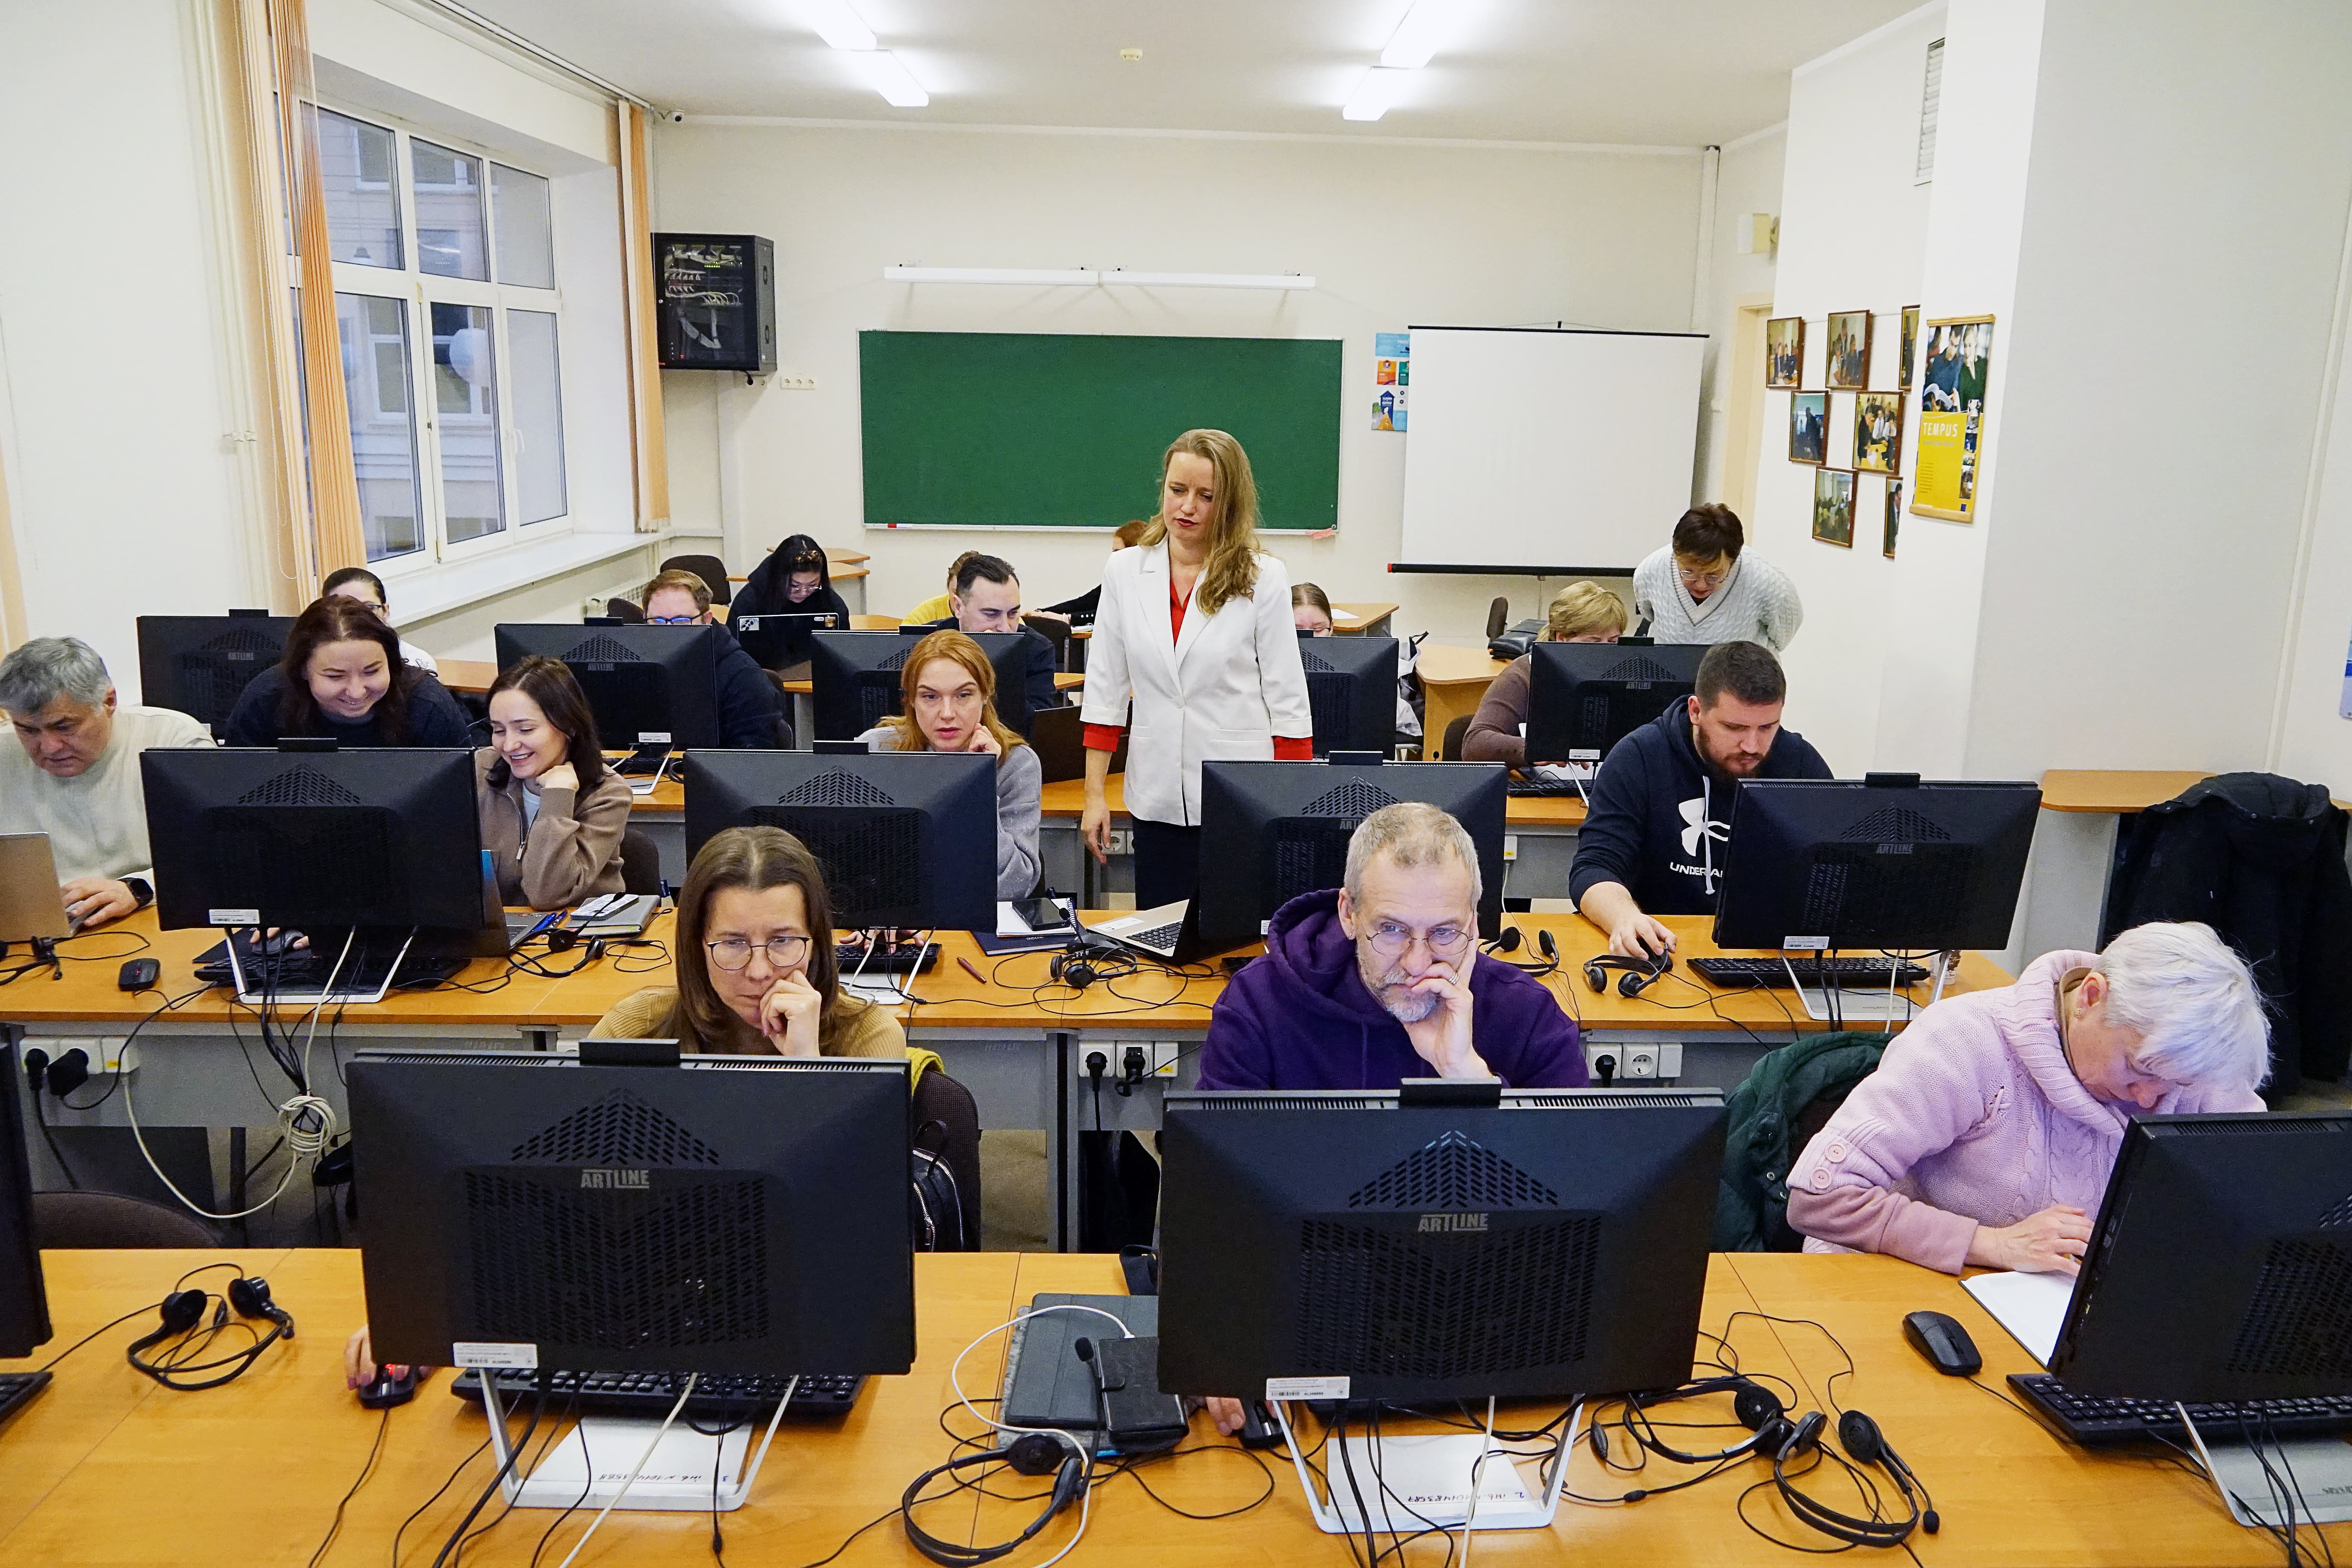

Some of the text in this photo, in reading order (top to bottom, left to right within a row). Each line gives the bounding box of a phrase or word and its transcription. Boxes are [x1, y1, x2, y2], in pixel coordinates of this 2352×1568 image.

[1923, 423, 1958, 437] TEMPUS
[1876, 844, 1914, 854] ARTLINE
[1670, 862, 1706, 876] UNDER
[581, 1169, 649, 1188] ARTLINE
[1418, 1213, 1488, 1232] ARTLINE
